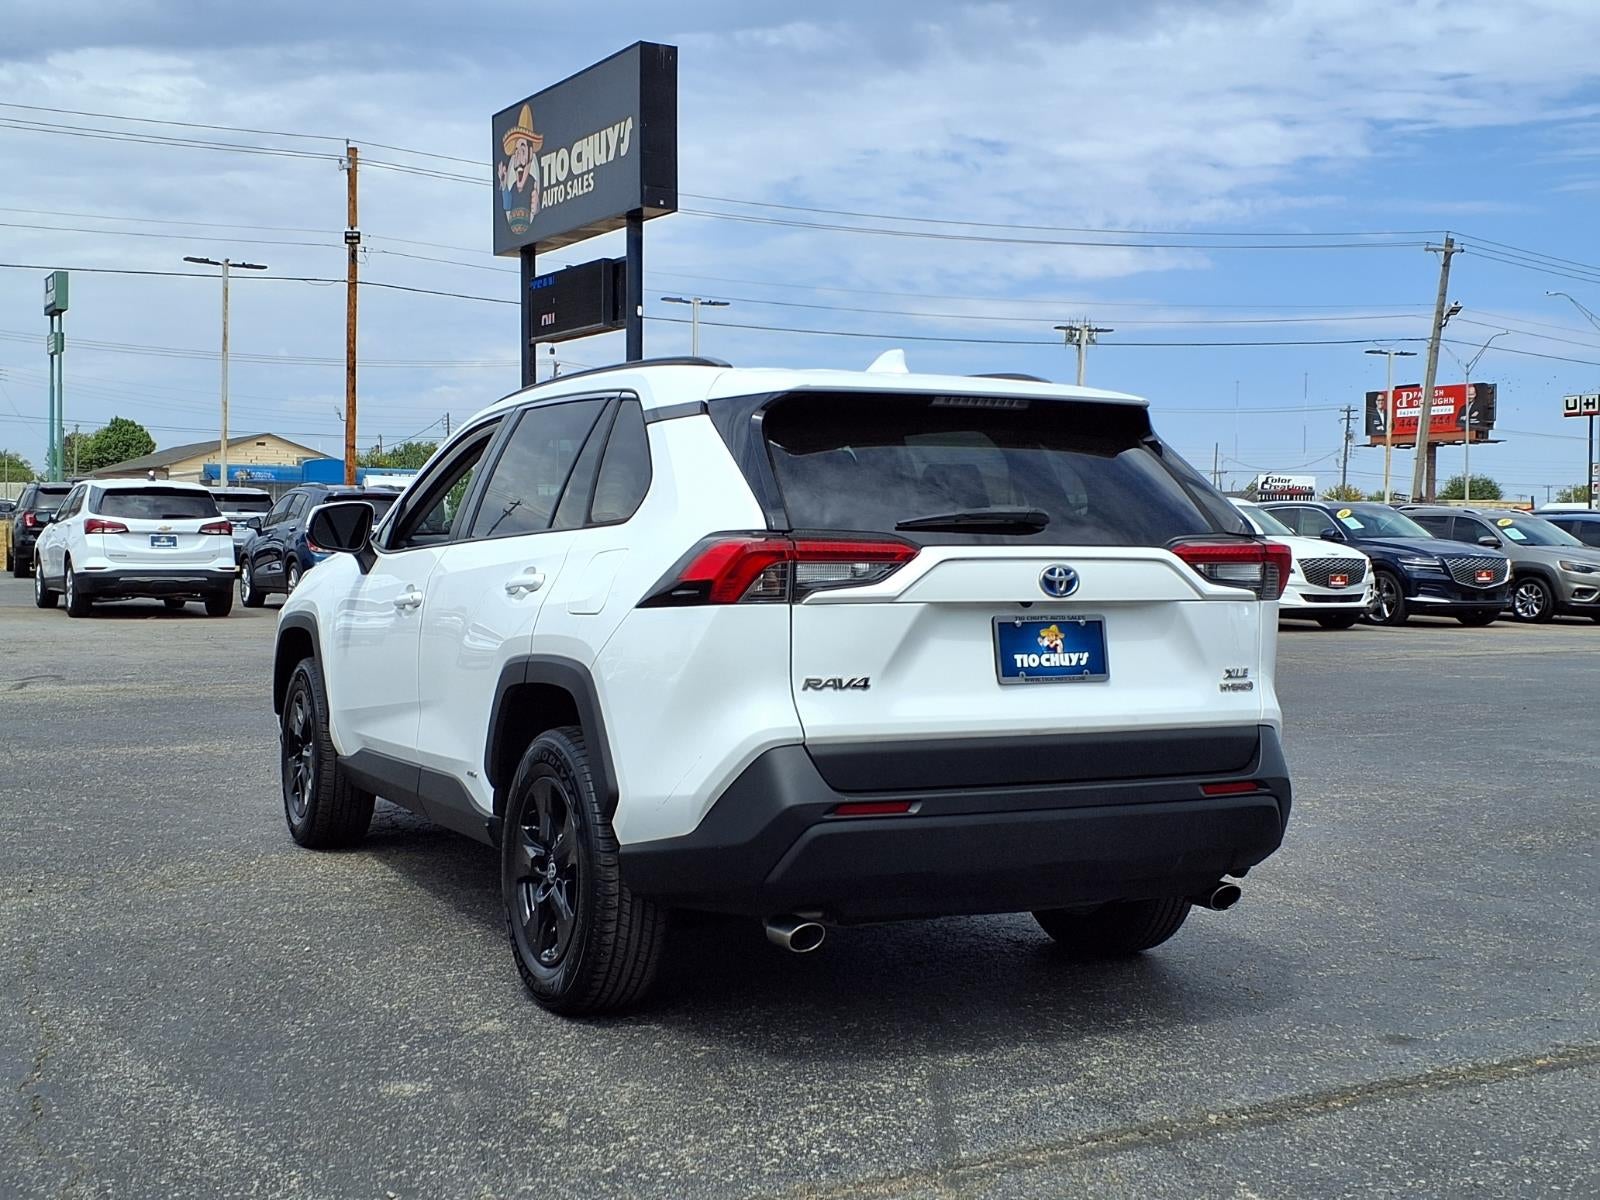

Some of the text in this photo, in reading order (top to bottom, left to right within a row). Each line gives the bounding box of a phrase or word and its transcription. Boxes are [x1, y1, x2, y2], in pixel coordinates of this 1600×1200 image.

[540, 116, 633, 188] TIO CHUY'S
[541, 172, 595, 209] AUTO SALES
[1413, 397, 1455, 407] DEUGHN
[1260, 481, 1314, 491] Creations
[1265, 476, 1293, 484] Color
[1013, 651, 1090, 668] TIO CHUY'S
[1223, 667, 1249, 680] XLE
[801, 676, 871, 691] RAV4
